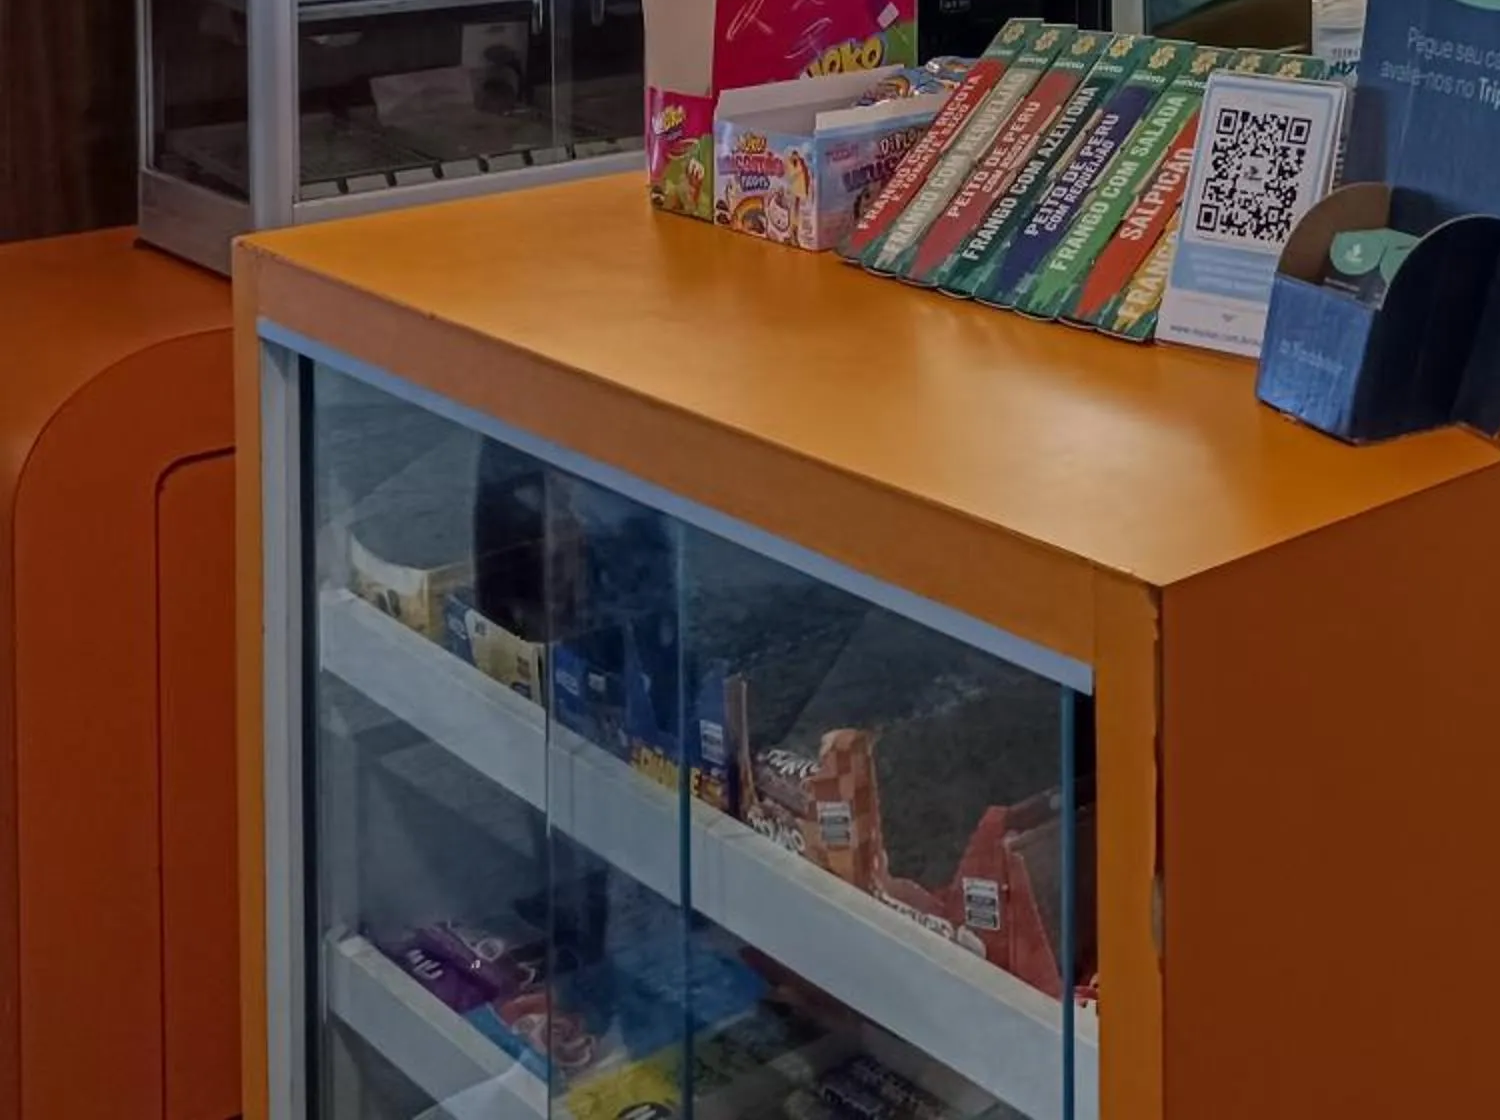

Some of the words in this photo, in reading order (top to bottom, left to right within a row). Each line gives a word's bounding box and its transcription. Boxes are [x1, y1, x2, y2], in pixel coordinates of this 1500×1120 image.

[1407, 27, 1454, 61] Pegue
[1456, 43, 1482, 66] seu
[1456, 80, 1475, 98] no
[883, 190, 938, 252] FRANGO
[929, 152, 968, 187] COM
[946, 170, 990, 217] PEITO
[983, 144, 1008, 166] DE
[1002, 100, 1041, 141] PERU
[961, 197, 1018, 259] FRANGO
[1009, 159, 1045, 193] COM
[1037, 86, 1100, 157] AZEITONA
[1023, 185, 1069, 235] PEITO
[1061, 159, 1087, 183] DE
[1079, 112, 1120, 157] PERU
[1049, 200, 1110, 270] FRANGO
[1100, 159, 1139, 198] COM
[1129, 95, 1188, 157] SALADA
[1117, 145, 1194, 240] SALPICÃO
[1043, 203, 1070, 232] COM
